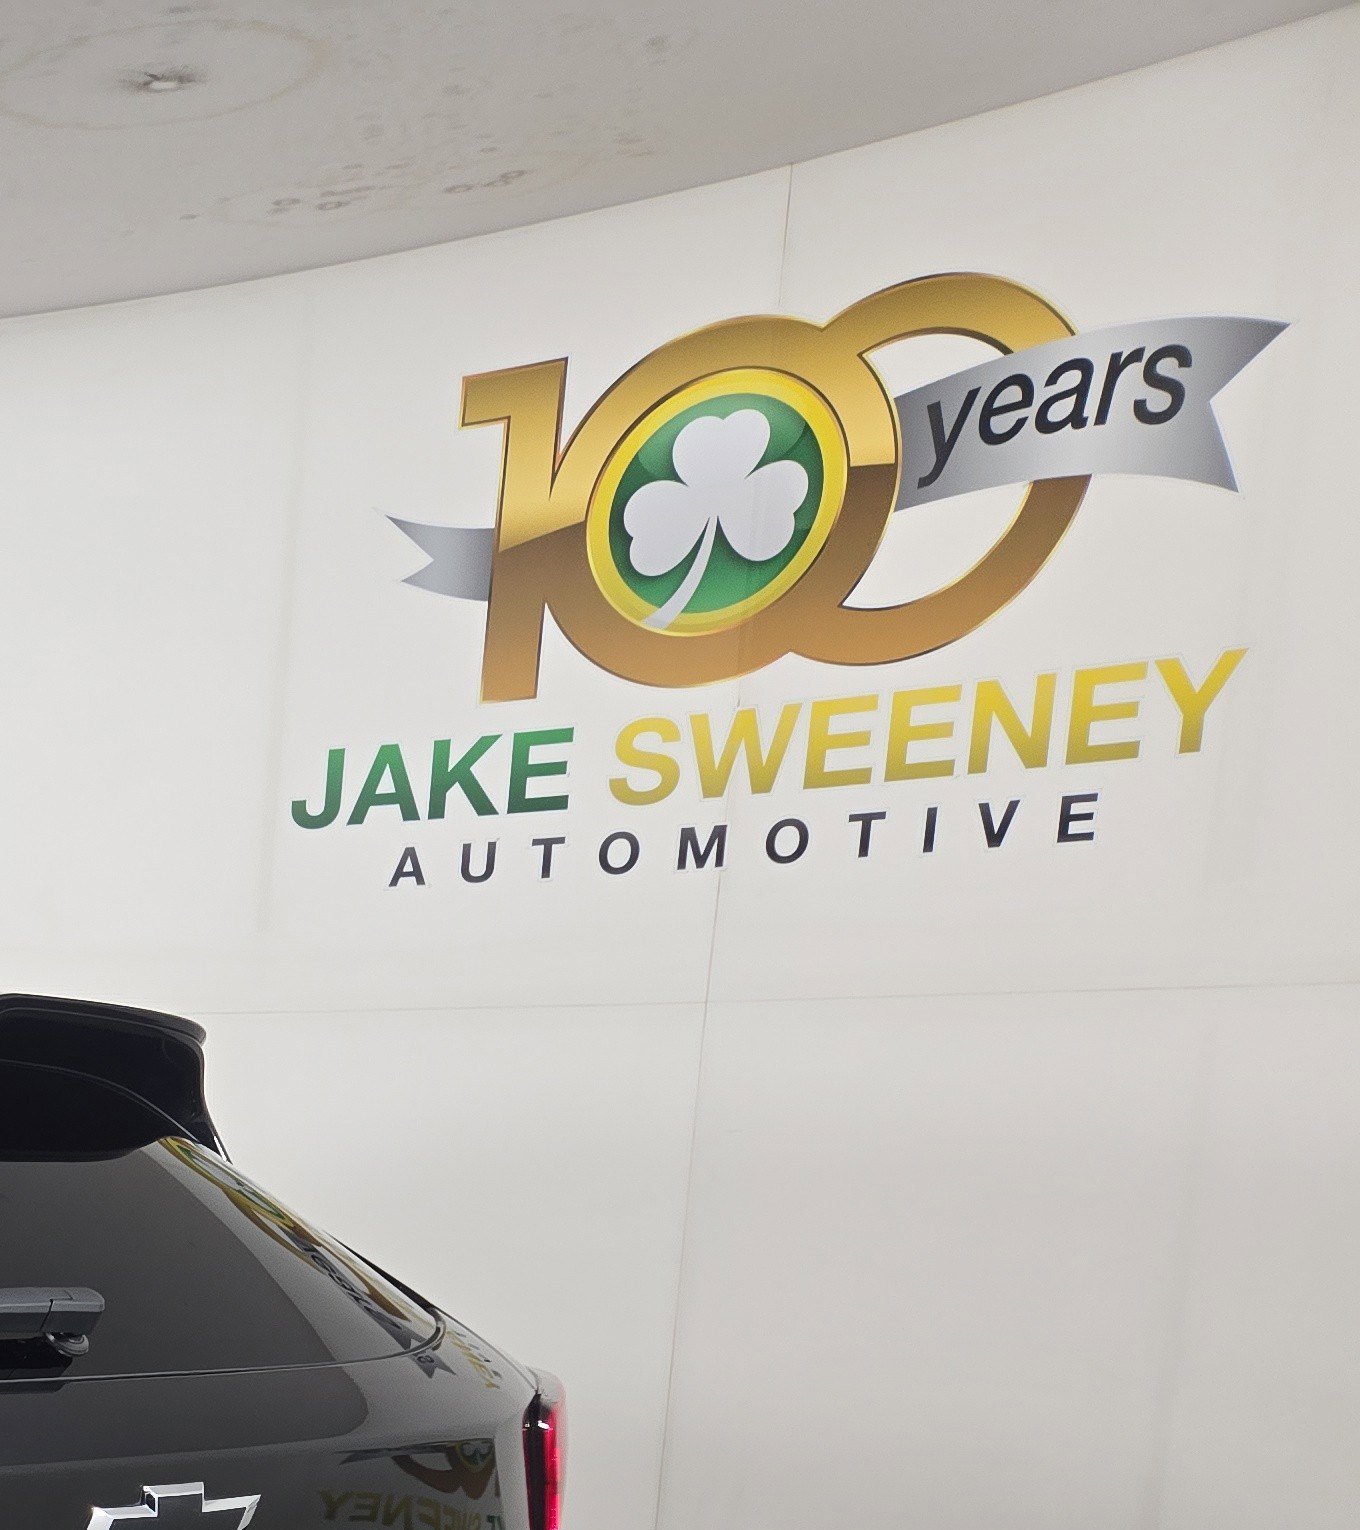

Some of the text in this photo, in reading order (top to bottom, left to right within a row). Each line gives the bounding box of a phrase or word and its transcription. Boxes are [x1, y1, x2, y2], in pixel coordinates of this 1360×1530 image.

[916, 342, 1193, 489] years
[291, 648, 1248, 831] JAKE SWEENEY
[388, 793, 1100, 888] AUTOMOTIVE
